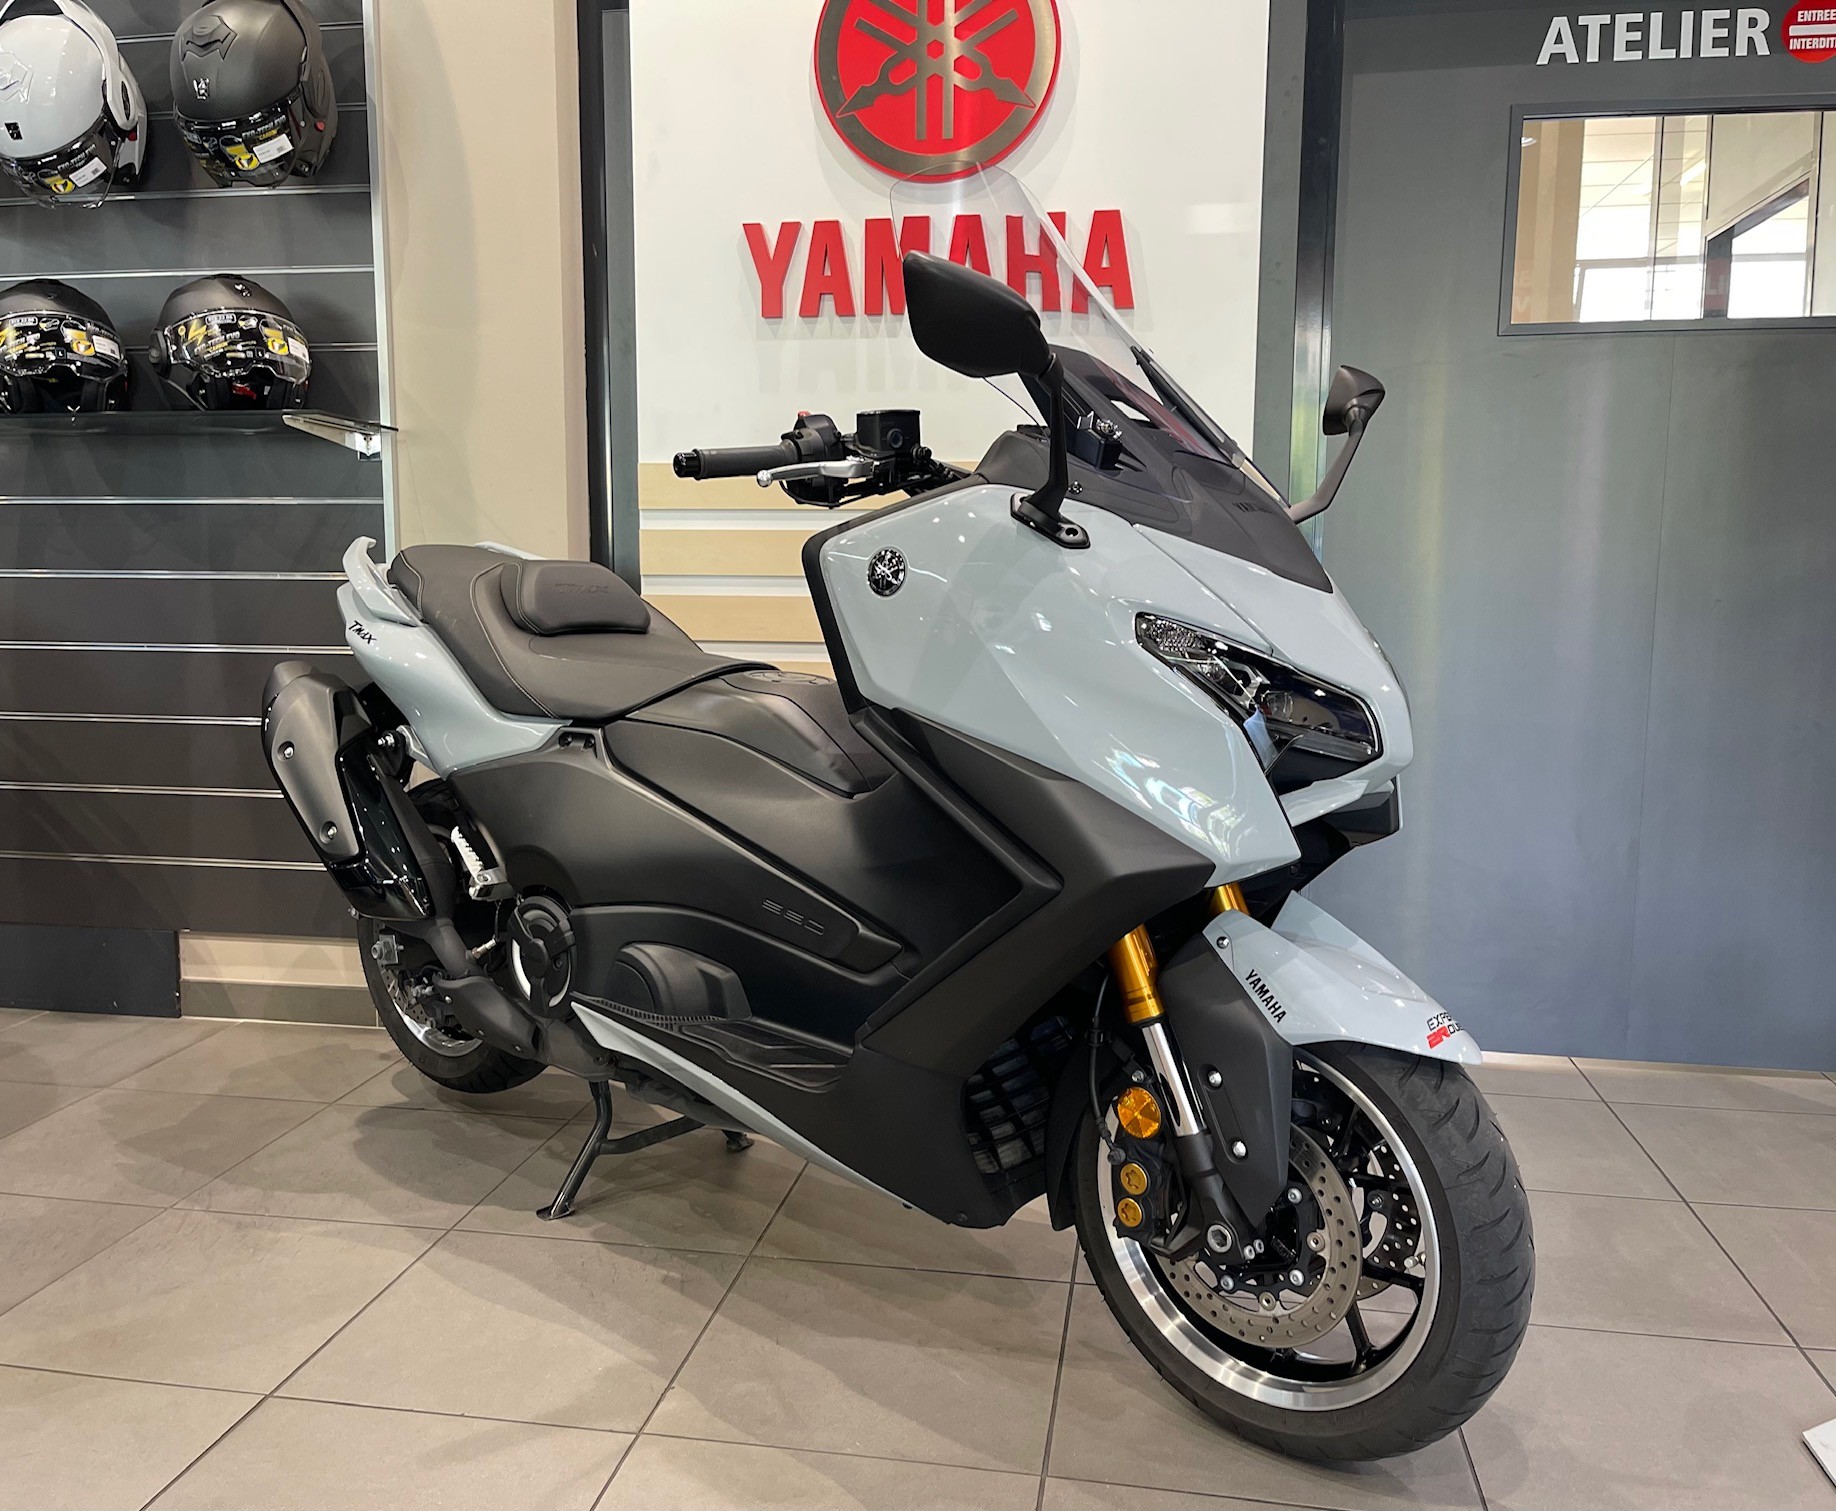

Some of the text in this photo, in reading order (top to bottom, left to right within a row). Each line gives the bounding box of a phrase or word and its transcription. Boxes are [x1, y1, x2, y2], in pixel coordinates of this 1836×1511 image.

[1536, 8, 1771, 65] ATELIER
[1789, 37, 1836, 50] INTERDIT
[1797, 9, 1836, 22] ENTREE
[742, 209, 1135, 318] YAMAHA
[1245, 968, 1287, 1024] YAMAHA
